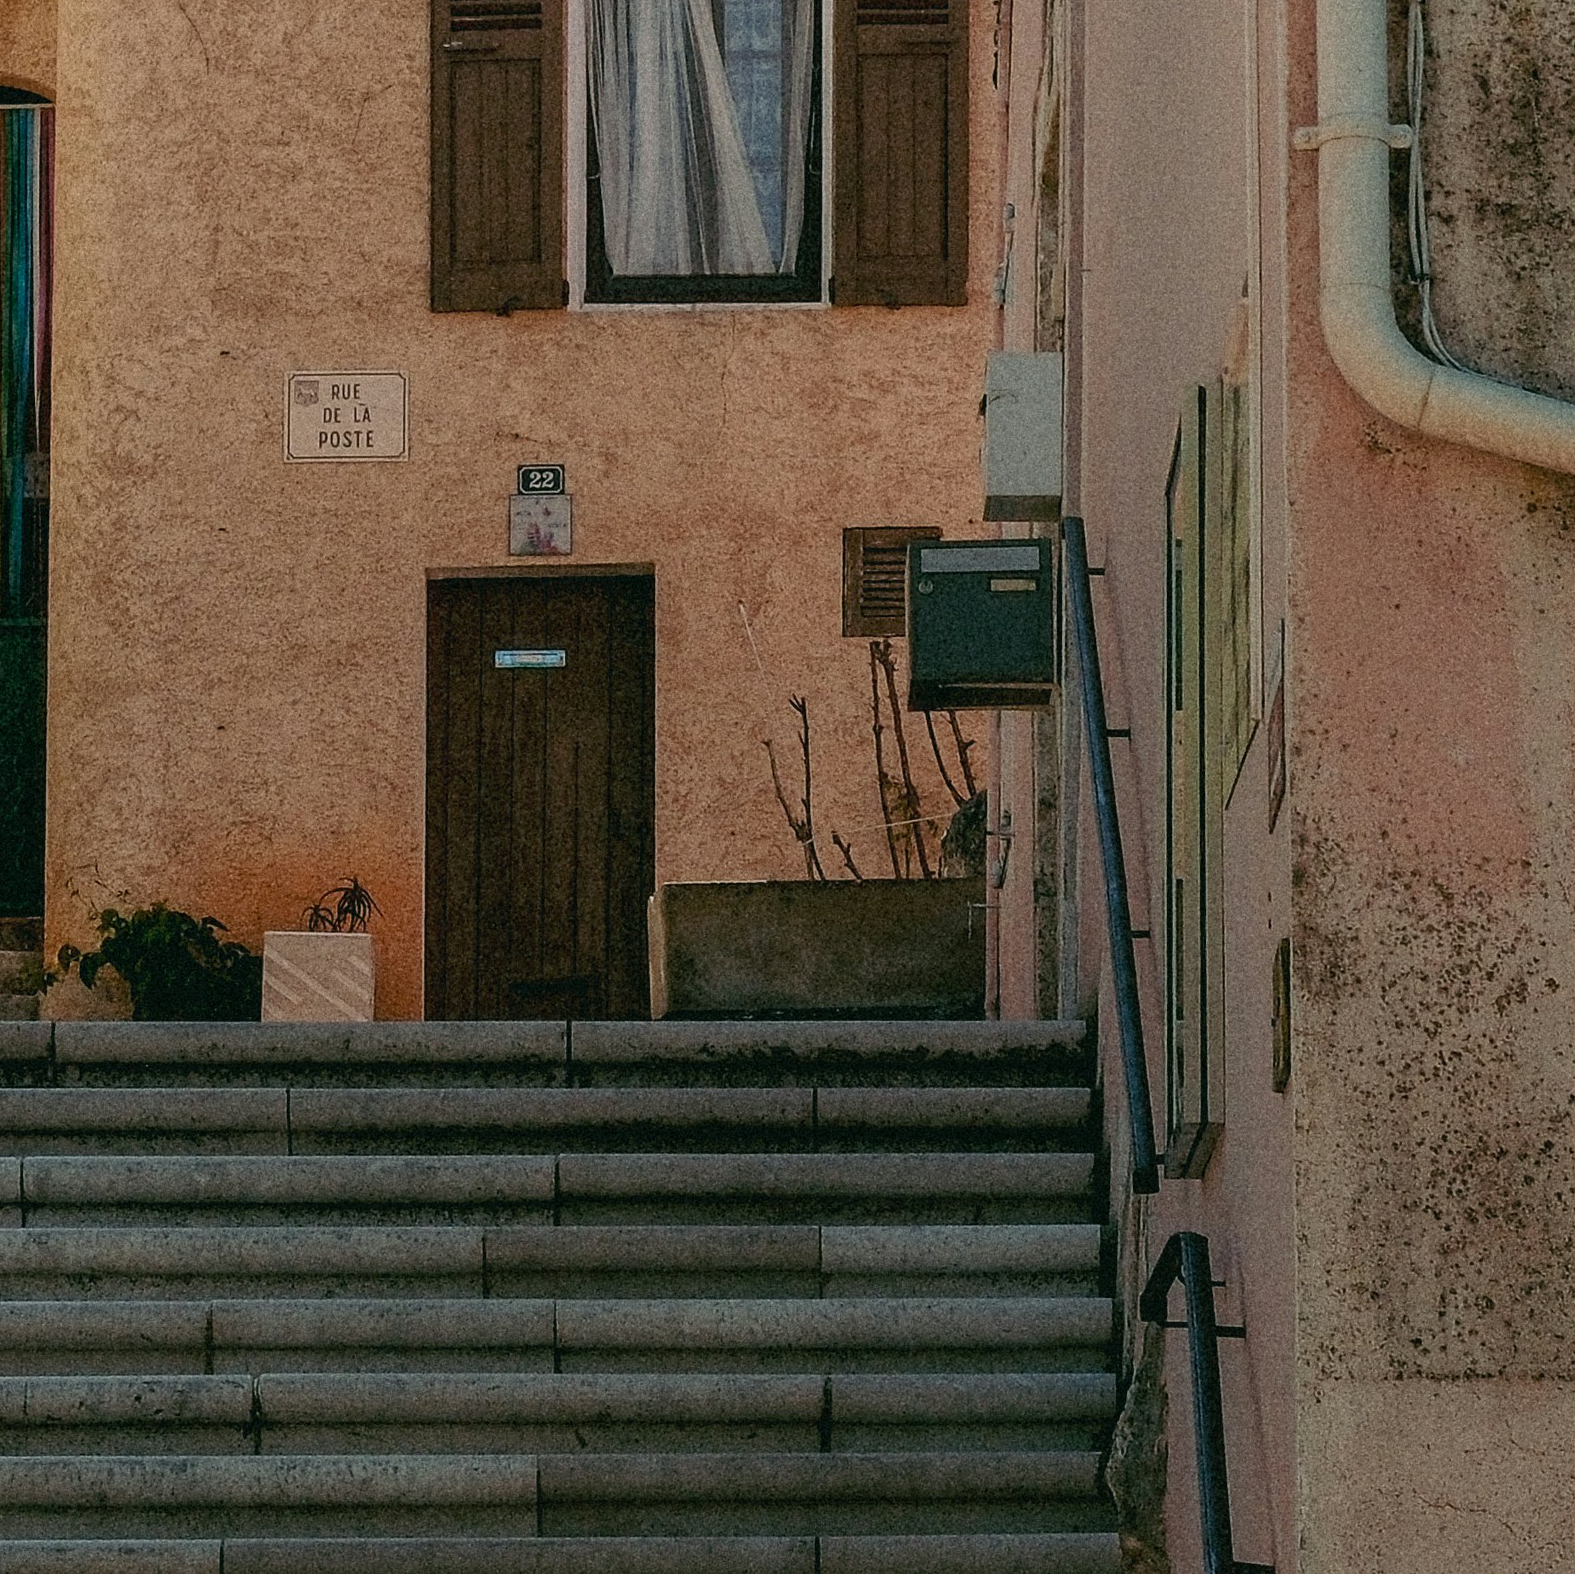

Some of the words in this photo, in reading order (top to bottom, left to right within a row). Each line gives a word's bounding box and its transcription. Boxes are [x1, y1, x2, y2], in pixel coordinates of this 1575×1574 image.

[331, 383, 361, 401] RUE
[323, 407, 342, 424] DE
[353, 407, 372, 423] LA
[319, 431, 374, 449] POSTE
[529, 471, 554, 489] 22
